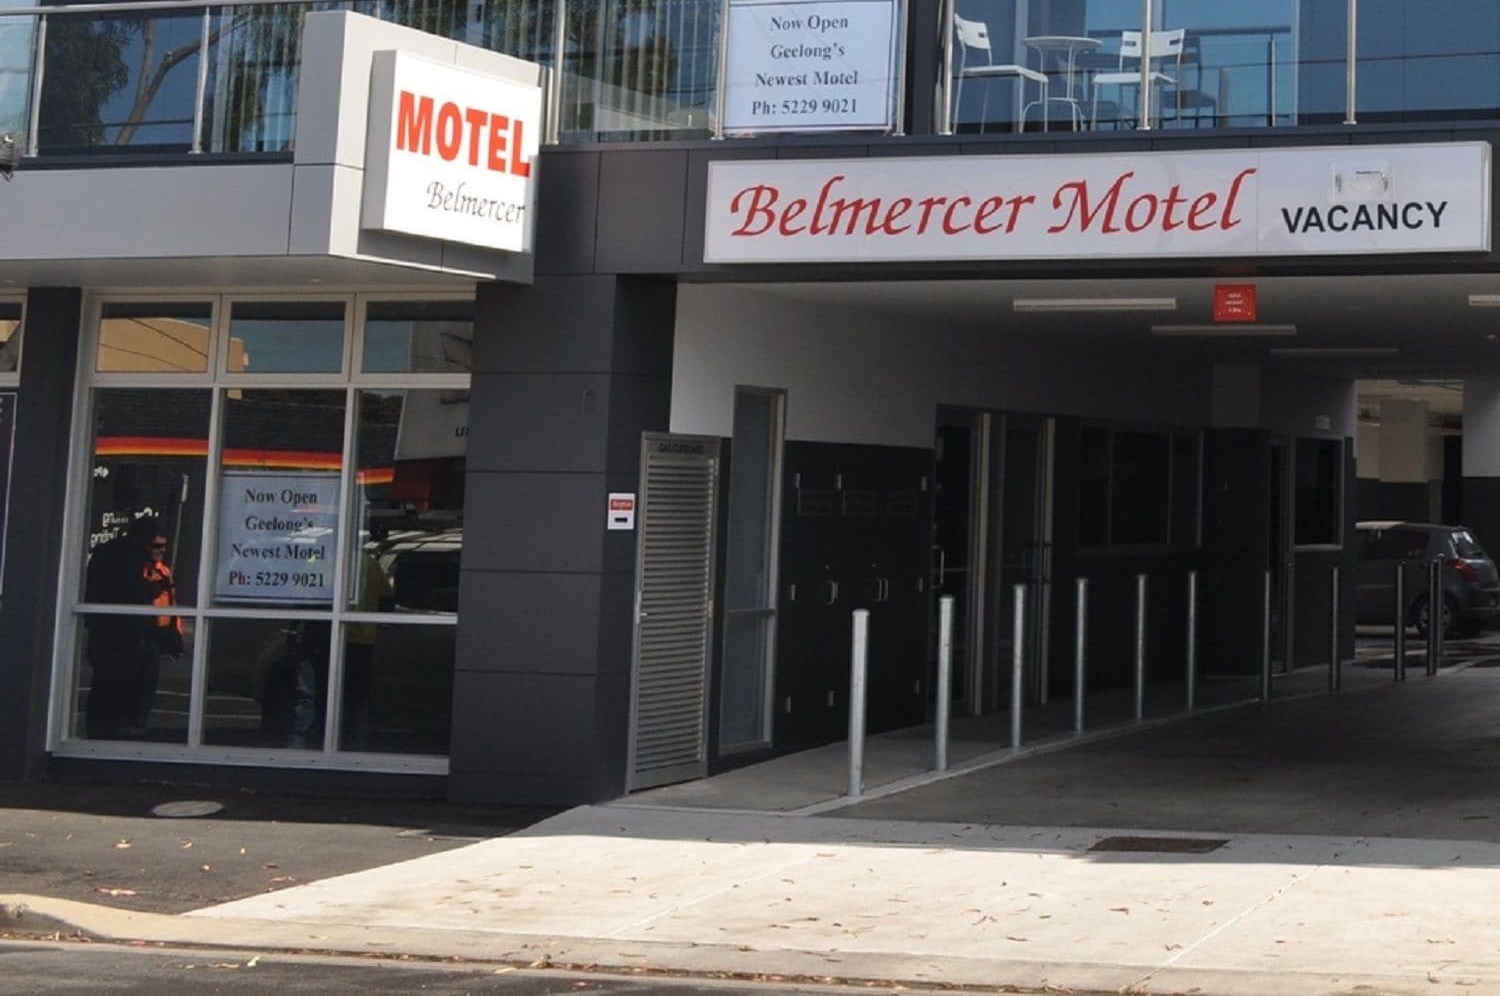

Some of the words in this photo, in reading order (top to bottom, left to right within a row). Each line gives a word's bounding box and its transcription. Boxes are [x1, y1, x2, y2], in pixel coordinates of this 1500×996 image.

[769, 16, 803, 32] Now
[807, 14, 849, 33] Open
[769, 42, 846, 61] Geelong's
[754, 71, 808, 88] Newest
[812, 70, 859, 86] Motel
[751, 100, 776, 116] Ph:
[781, 99, 818, 115] 5229
[822, 98, 857, 114] 9021
[396, 90, 531, 178] MOTEL
[427, 180, 526, 224] Belmercer
[729, 175, 1036, 237] Belmercer
[1046, 167, 1258, 235] Motel
[1281, 201, 1448, 234] VACANCY
[244, 488, 277, 504] Now
[280, 489, 318, 507] Open
[245, 515, 314, 533] Geelong's
[230, 543, 281, 559] Newest
[285, 544, 326, 560] Motel
[228, 570, 251, 586] Ph:
[255, 572, 289, 587] 5229
[292, 573, 325, 588] 9021
